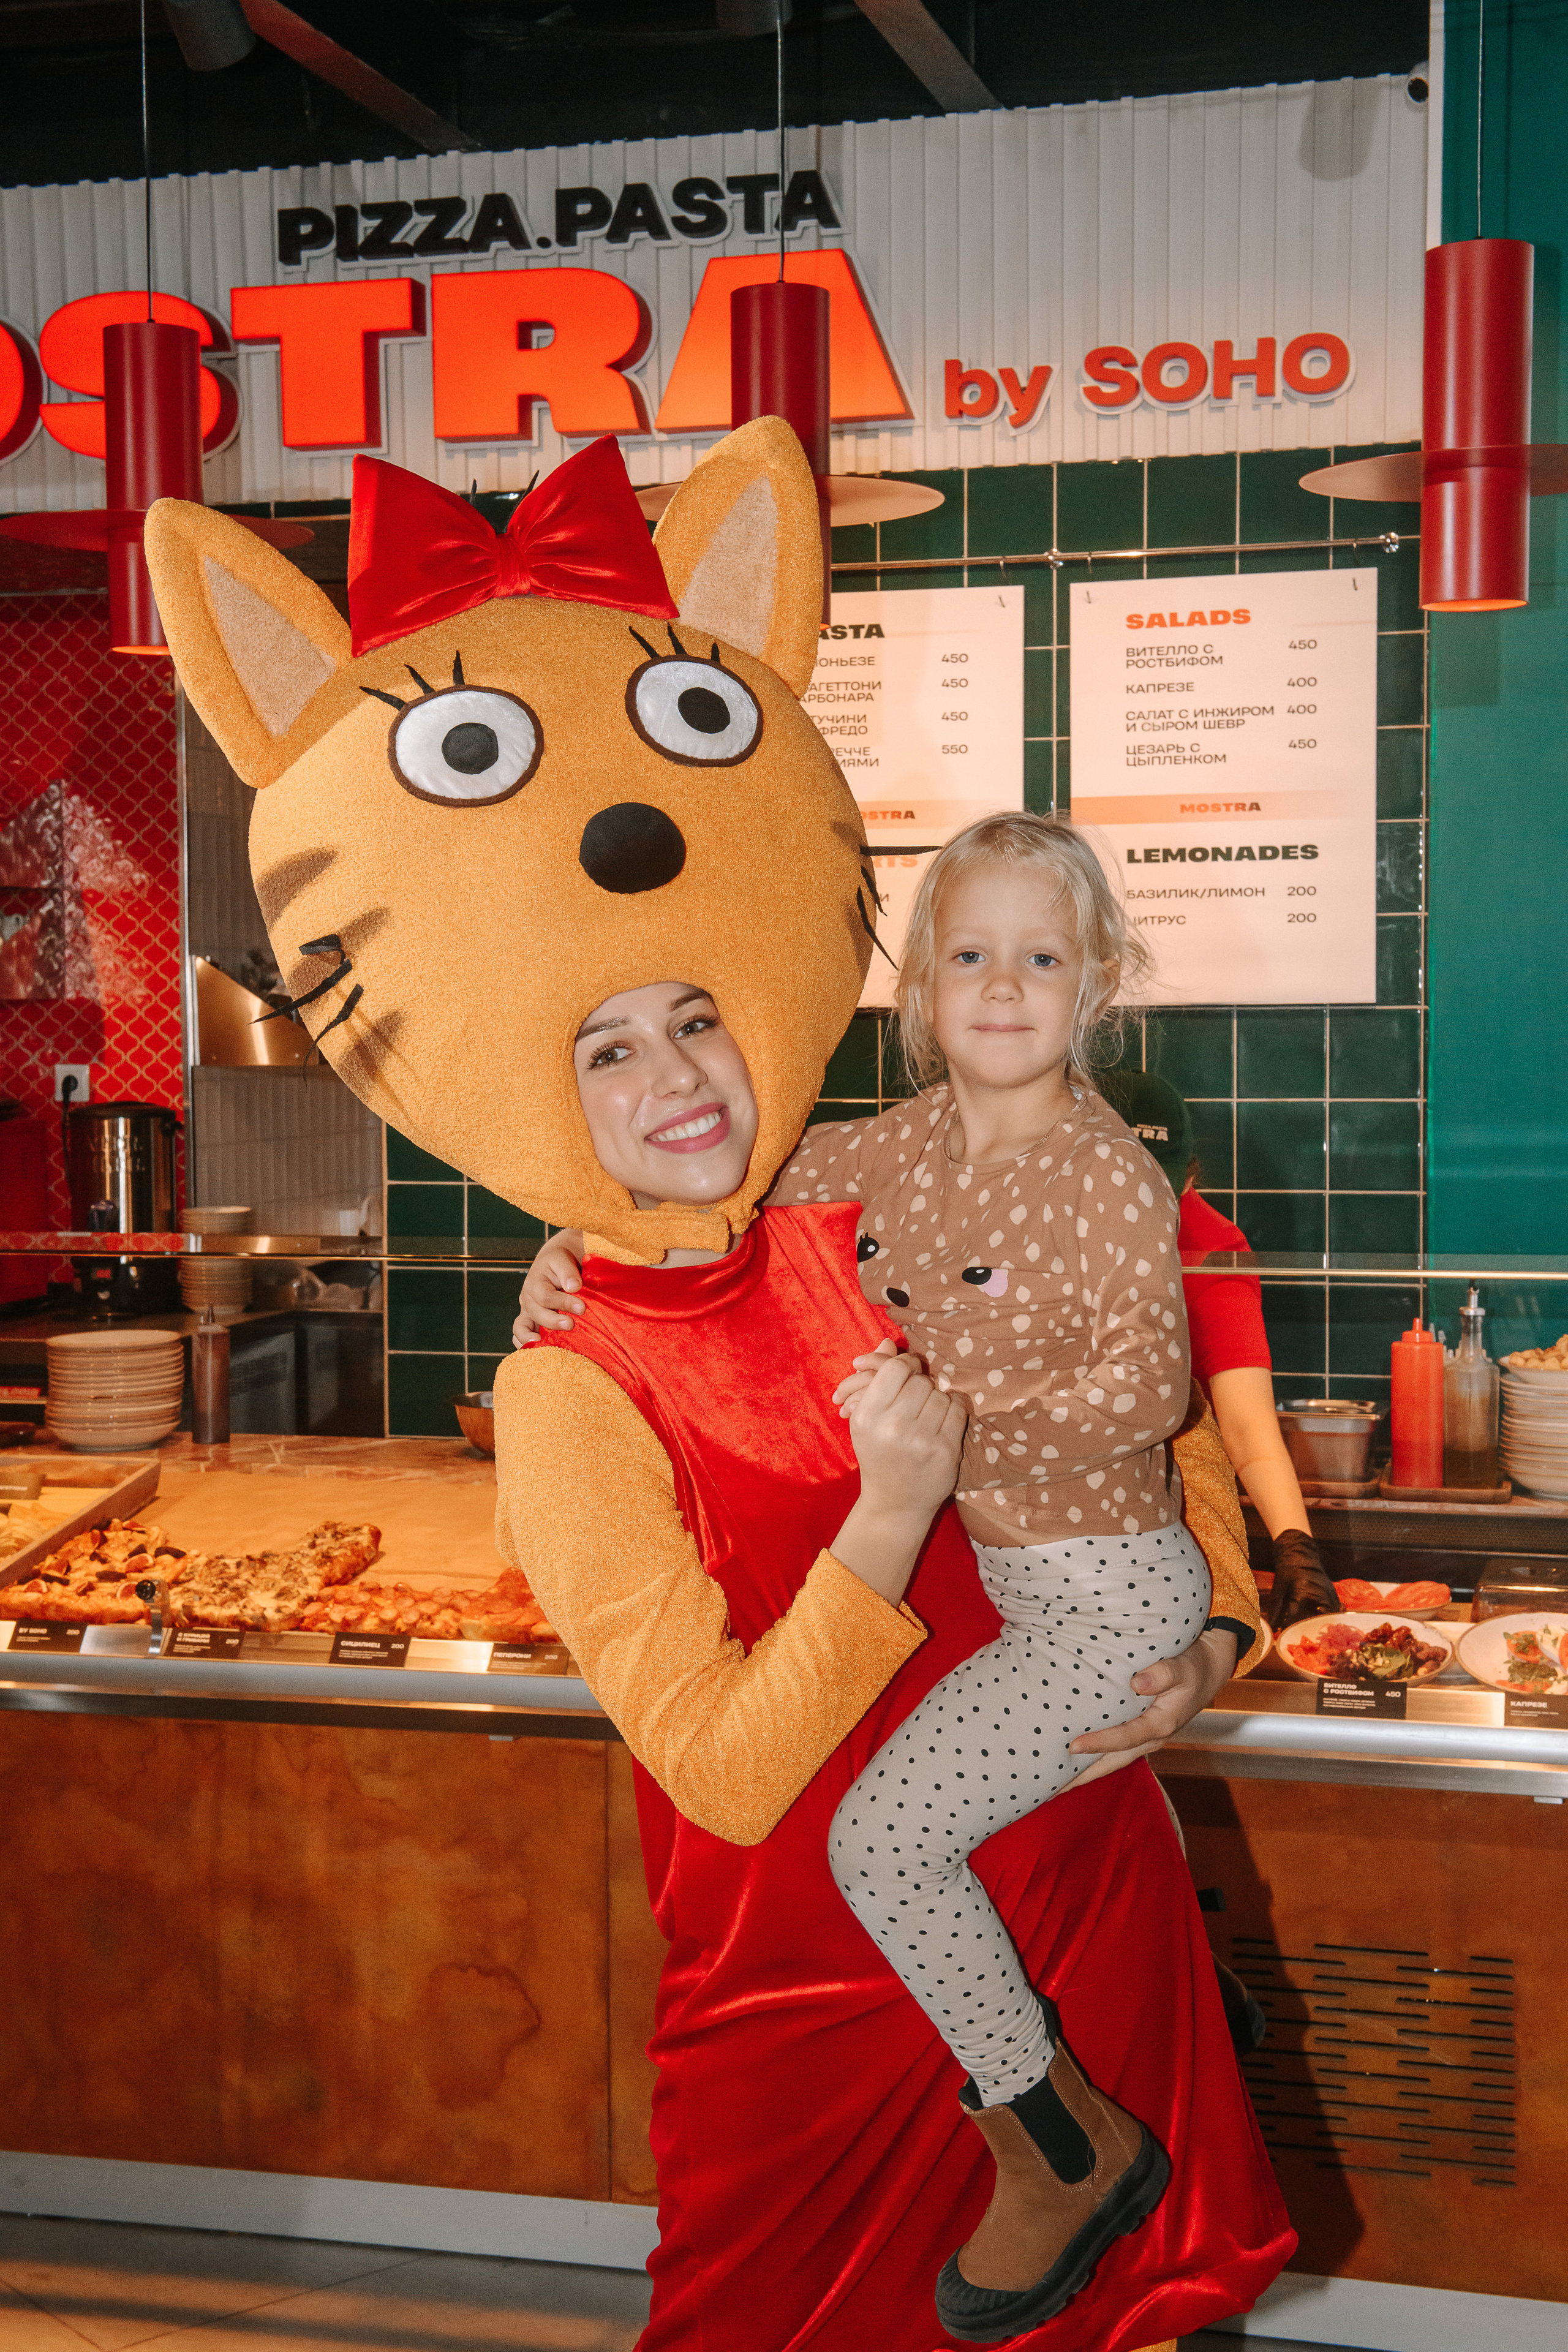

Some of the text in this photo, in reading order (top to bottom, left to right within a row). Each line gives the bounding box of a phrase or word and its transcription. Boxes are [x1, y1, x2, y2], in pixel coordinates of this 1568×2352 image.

[277, 169, 842, 268] PIZZA.PASTA
[0, 249, 913, 459] STRA
[943, 332, 1351, 429] by SOHO
[1125, 608, 1252, 630] SALADS
[1126, 639, 1318, 657] ВИТЕЛЛО С 450
[941, 653, 969, 664] 450
[1126, 655, 1224, 669] РОСТБИФОМ
[941, 678, 969, 688] 450
[1126, 676, 1318, 695] КАПРЕЗЕ 400
[941, 711, 969, 722] 450
[1126, 704, 1317, 721] САЛАТ С ИНЖИРОМ 400
[1126, 718, 1246, 733] И СЫРОМ ШЕВР
[831, 744, 969, 756] ЕЧЧЕ 550
[1126, 738, 1317, 756] ЦЕЗАРЬ С 450
[1126, 753, 1227, 767] ЦЫПЛЕНКОМ
[1179, 802, 1262, 814] MOSTRA
[1126, 843, 1320, 864] LEMONADES
[1126, 886, 1317, 900] БАЗИЛИК/ЛИМОН 200
[1286, 913, 1317, 924] 200
